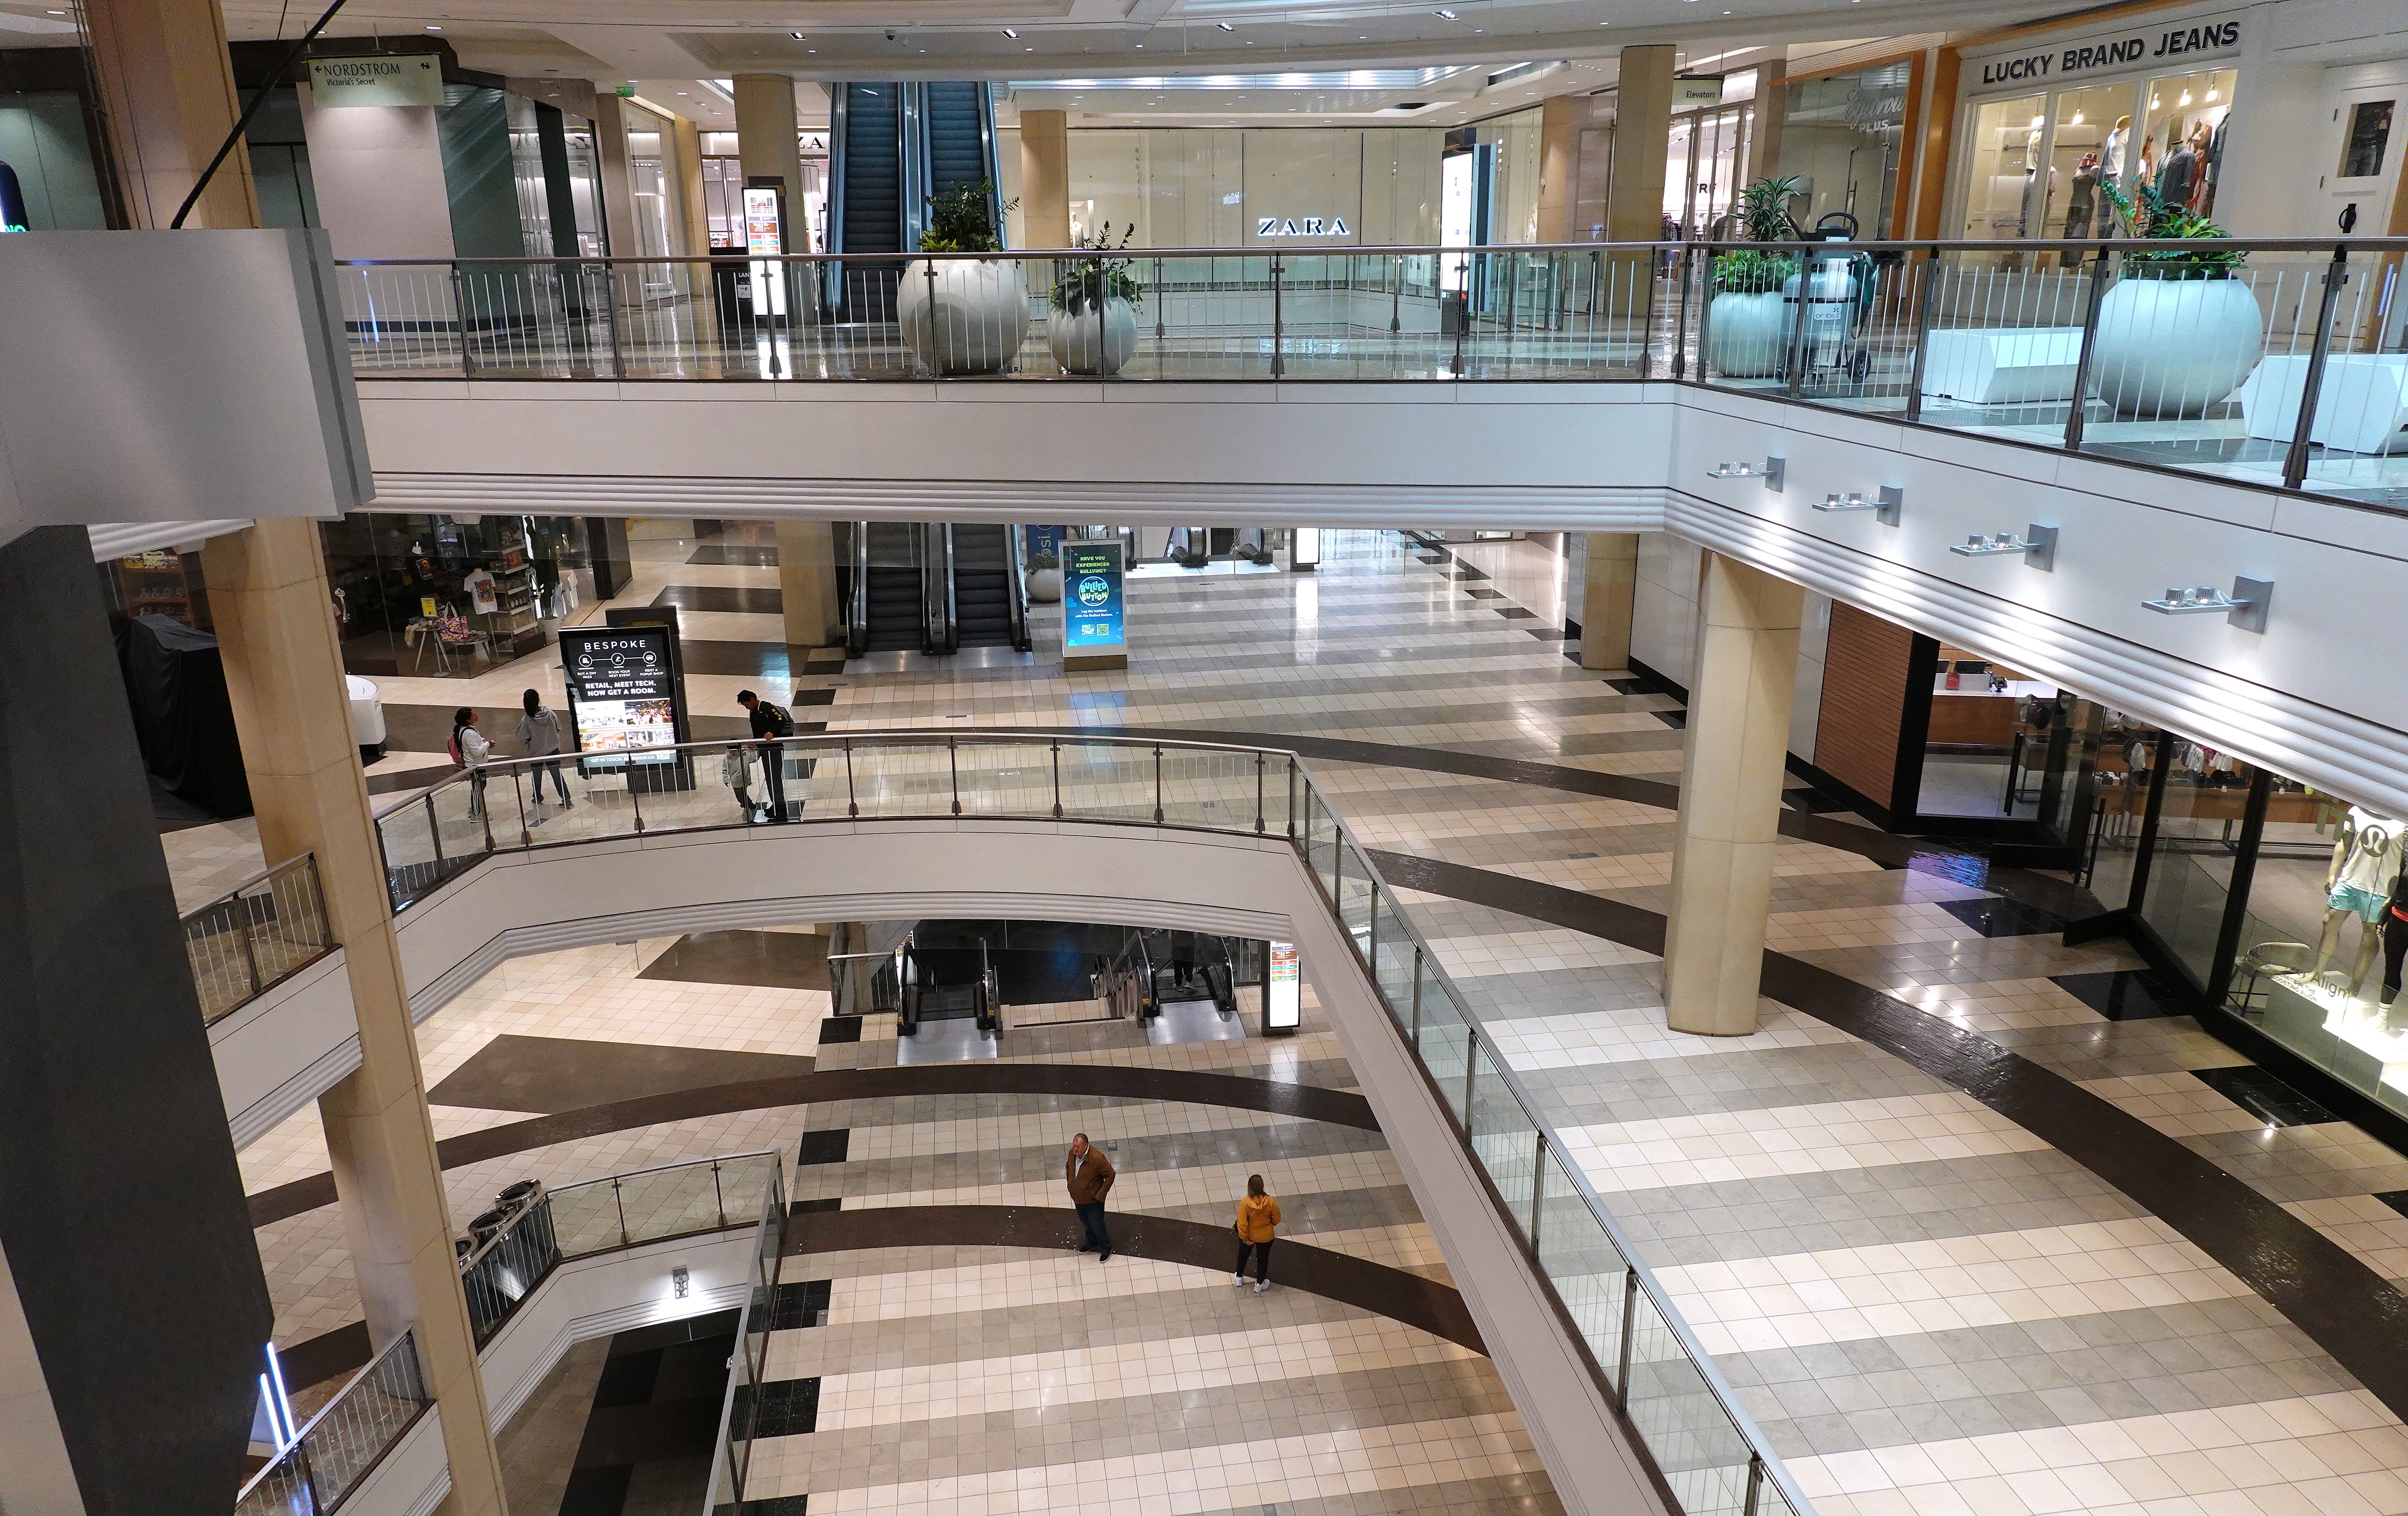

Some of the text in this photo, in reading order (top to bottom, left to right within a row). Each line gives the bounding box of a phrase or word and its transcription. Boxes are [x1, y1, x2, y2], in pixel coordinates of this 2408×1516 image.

[1983, 21, 2240, 85] LUCKY BRAND JEANS
[323, 62, 401, 76] NORDSTROM
[1258, 217, 1350, 236] ZARA
[1080, 581, 1107, 593] BULLIED
[1081, 591, 1107, 601] BUTTON
[584, 640, 646, 650] BESPOKE
[2300, 990, 2317, 1002] ALIGN
